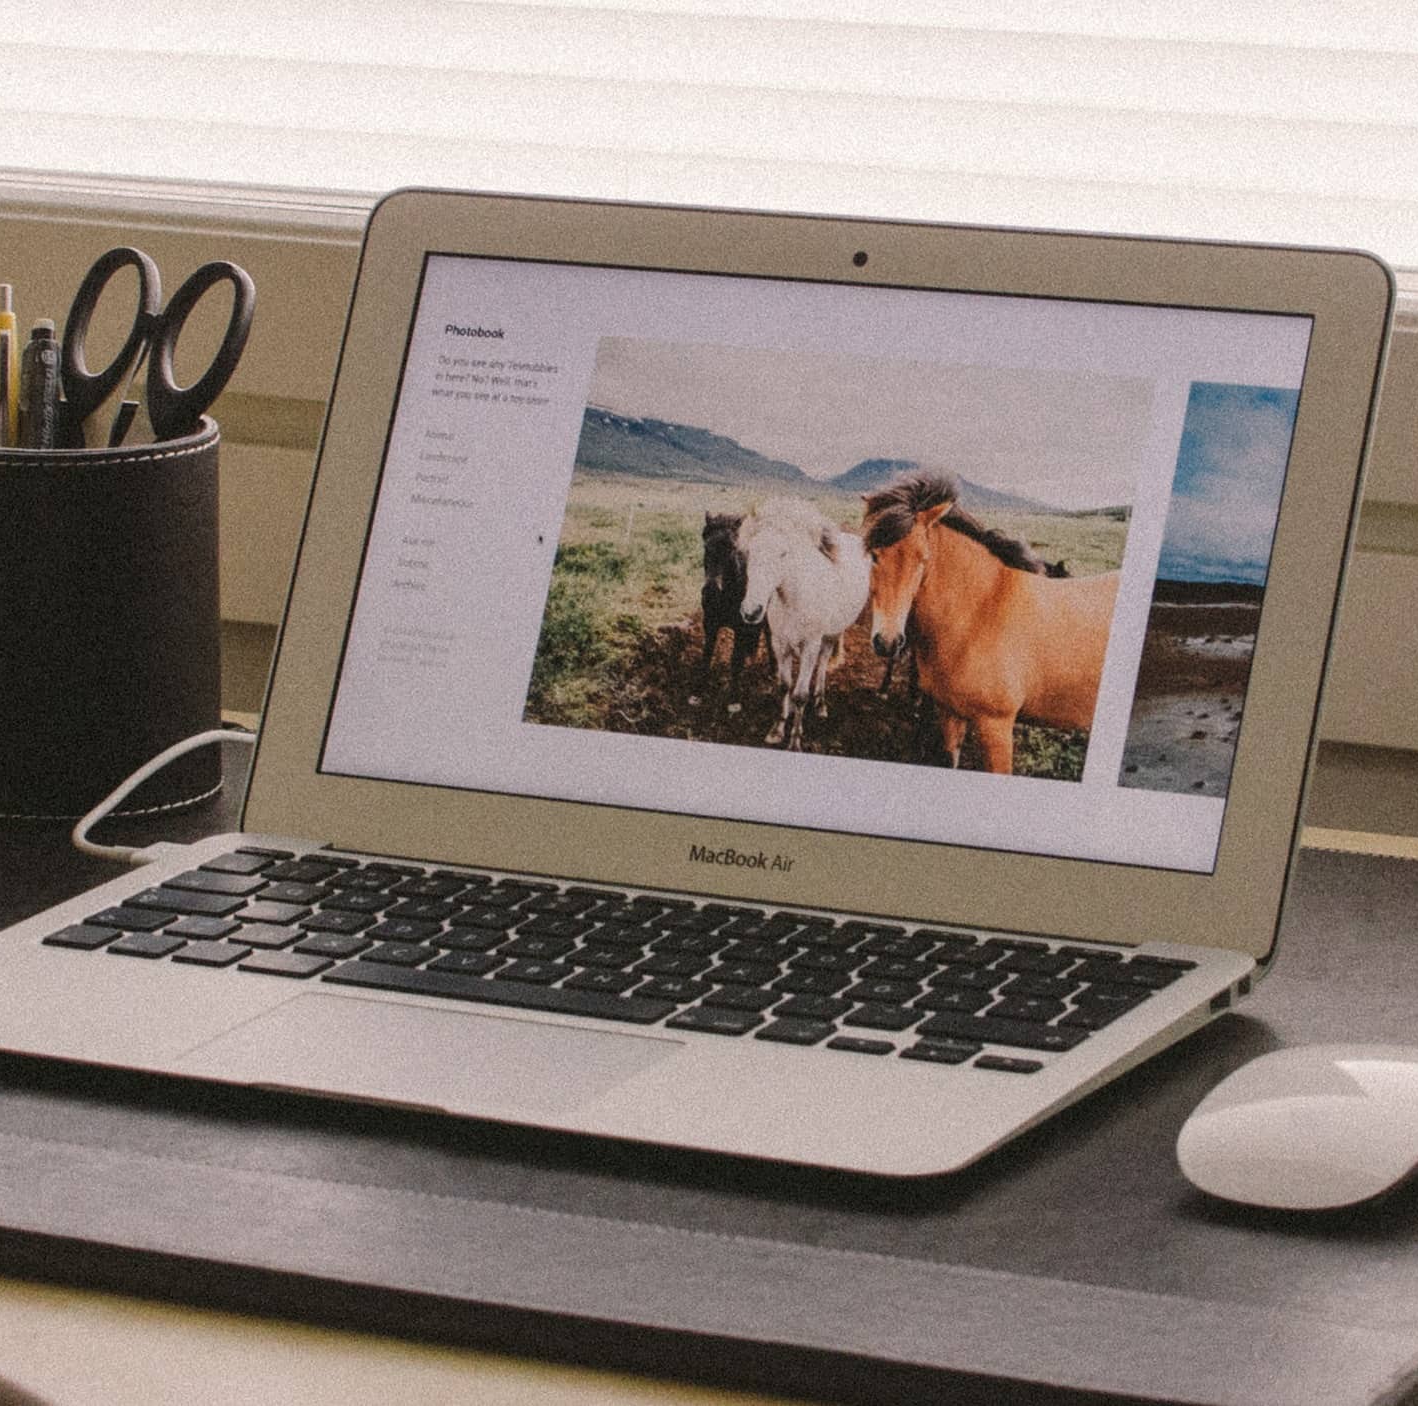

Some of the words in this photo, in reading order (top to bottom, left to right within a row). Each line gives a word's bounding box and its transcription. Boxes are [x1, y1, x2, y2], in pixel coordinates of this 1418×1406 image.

[445, 324, 505, 339] Photobook
[689, 844, 769, 870] MacBook
[771, 854, 795, 873] Air
